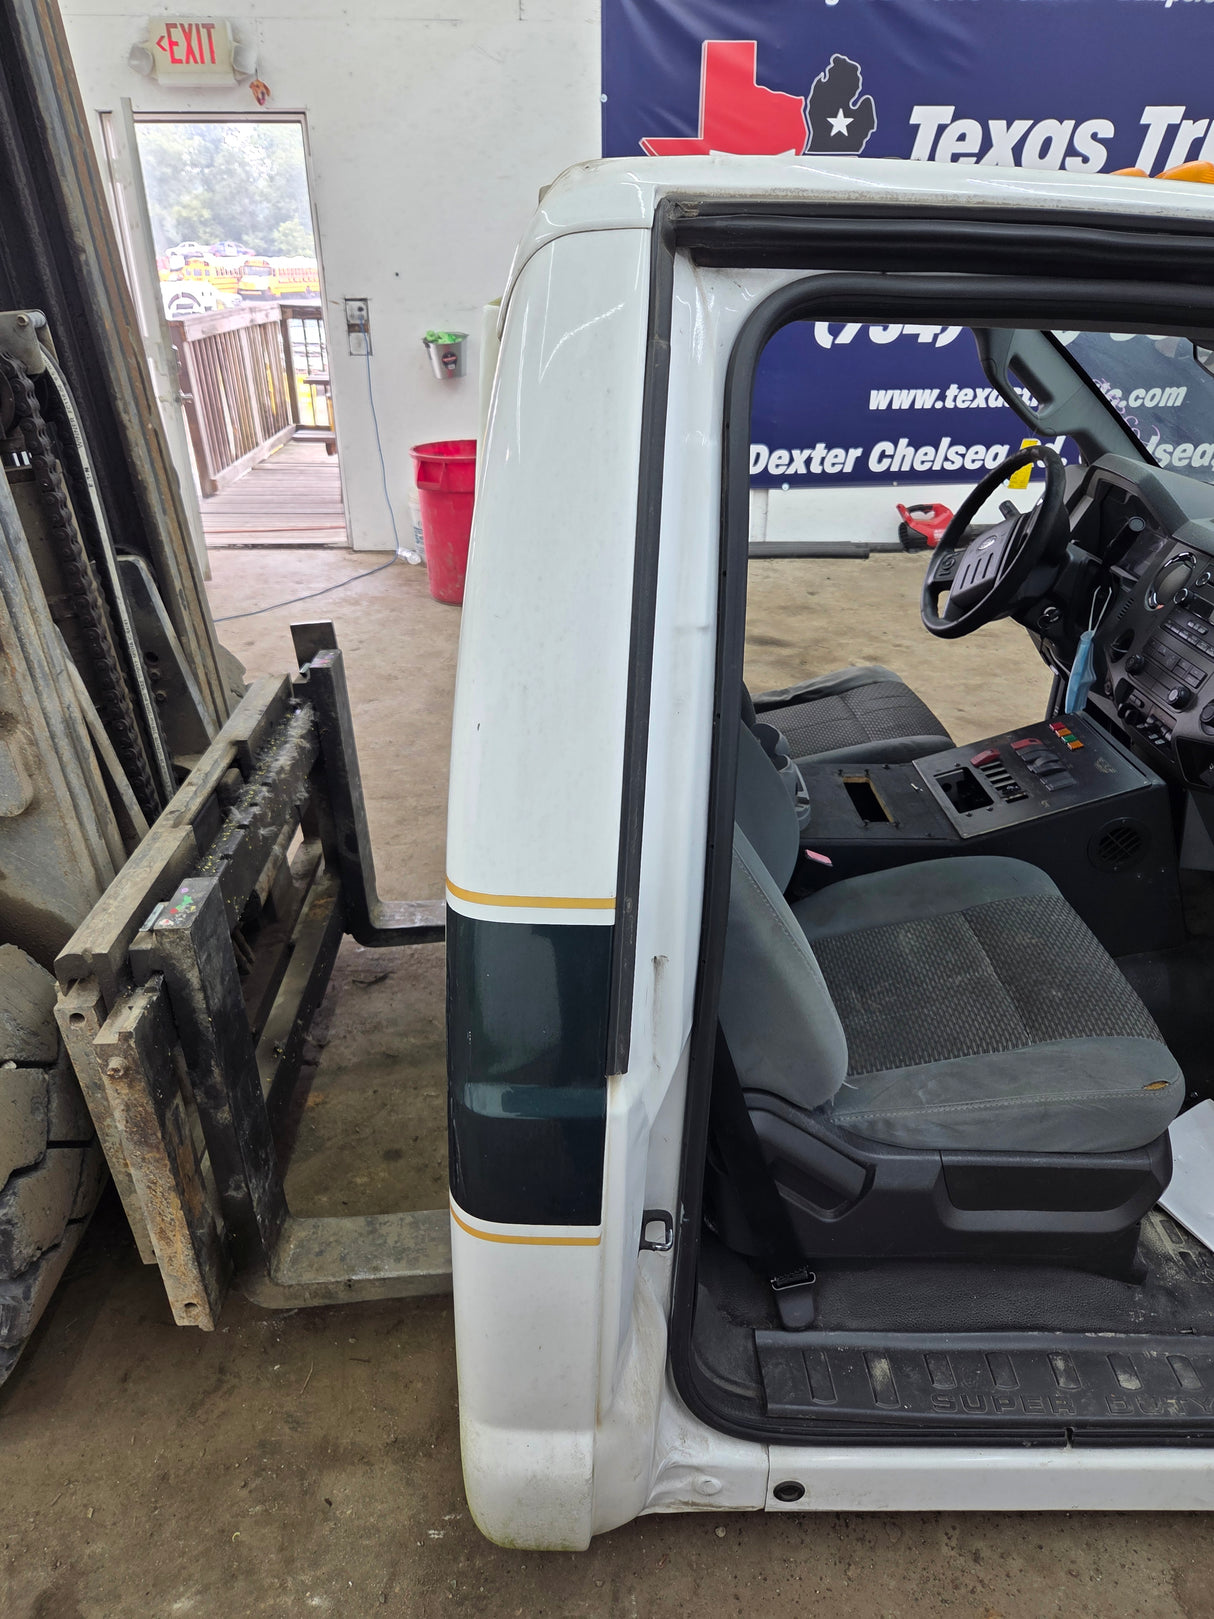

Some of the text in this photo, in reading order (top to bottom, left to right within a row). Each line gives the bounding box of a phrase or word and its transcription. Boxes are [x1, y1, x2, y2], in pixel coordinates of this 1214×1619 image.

[165, 23, 216, 64] EXIT
[909, 105, 1115, 173] Texas
[750, 443, 863, 475] Dexter
[868, 437, 1010, 472] Chelsea
[931, 1393, 1077, 1416] SUPER
